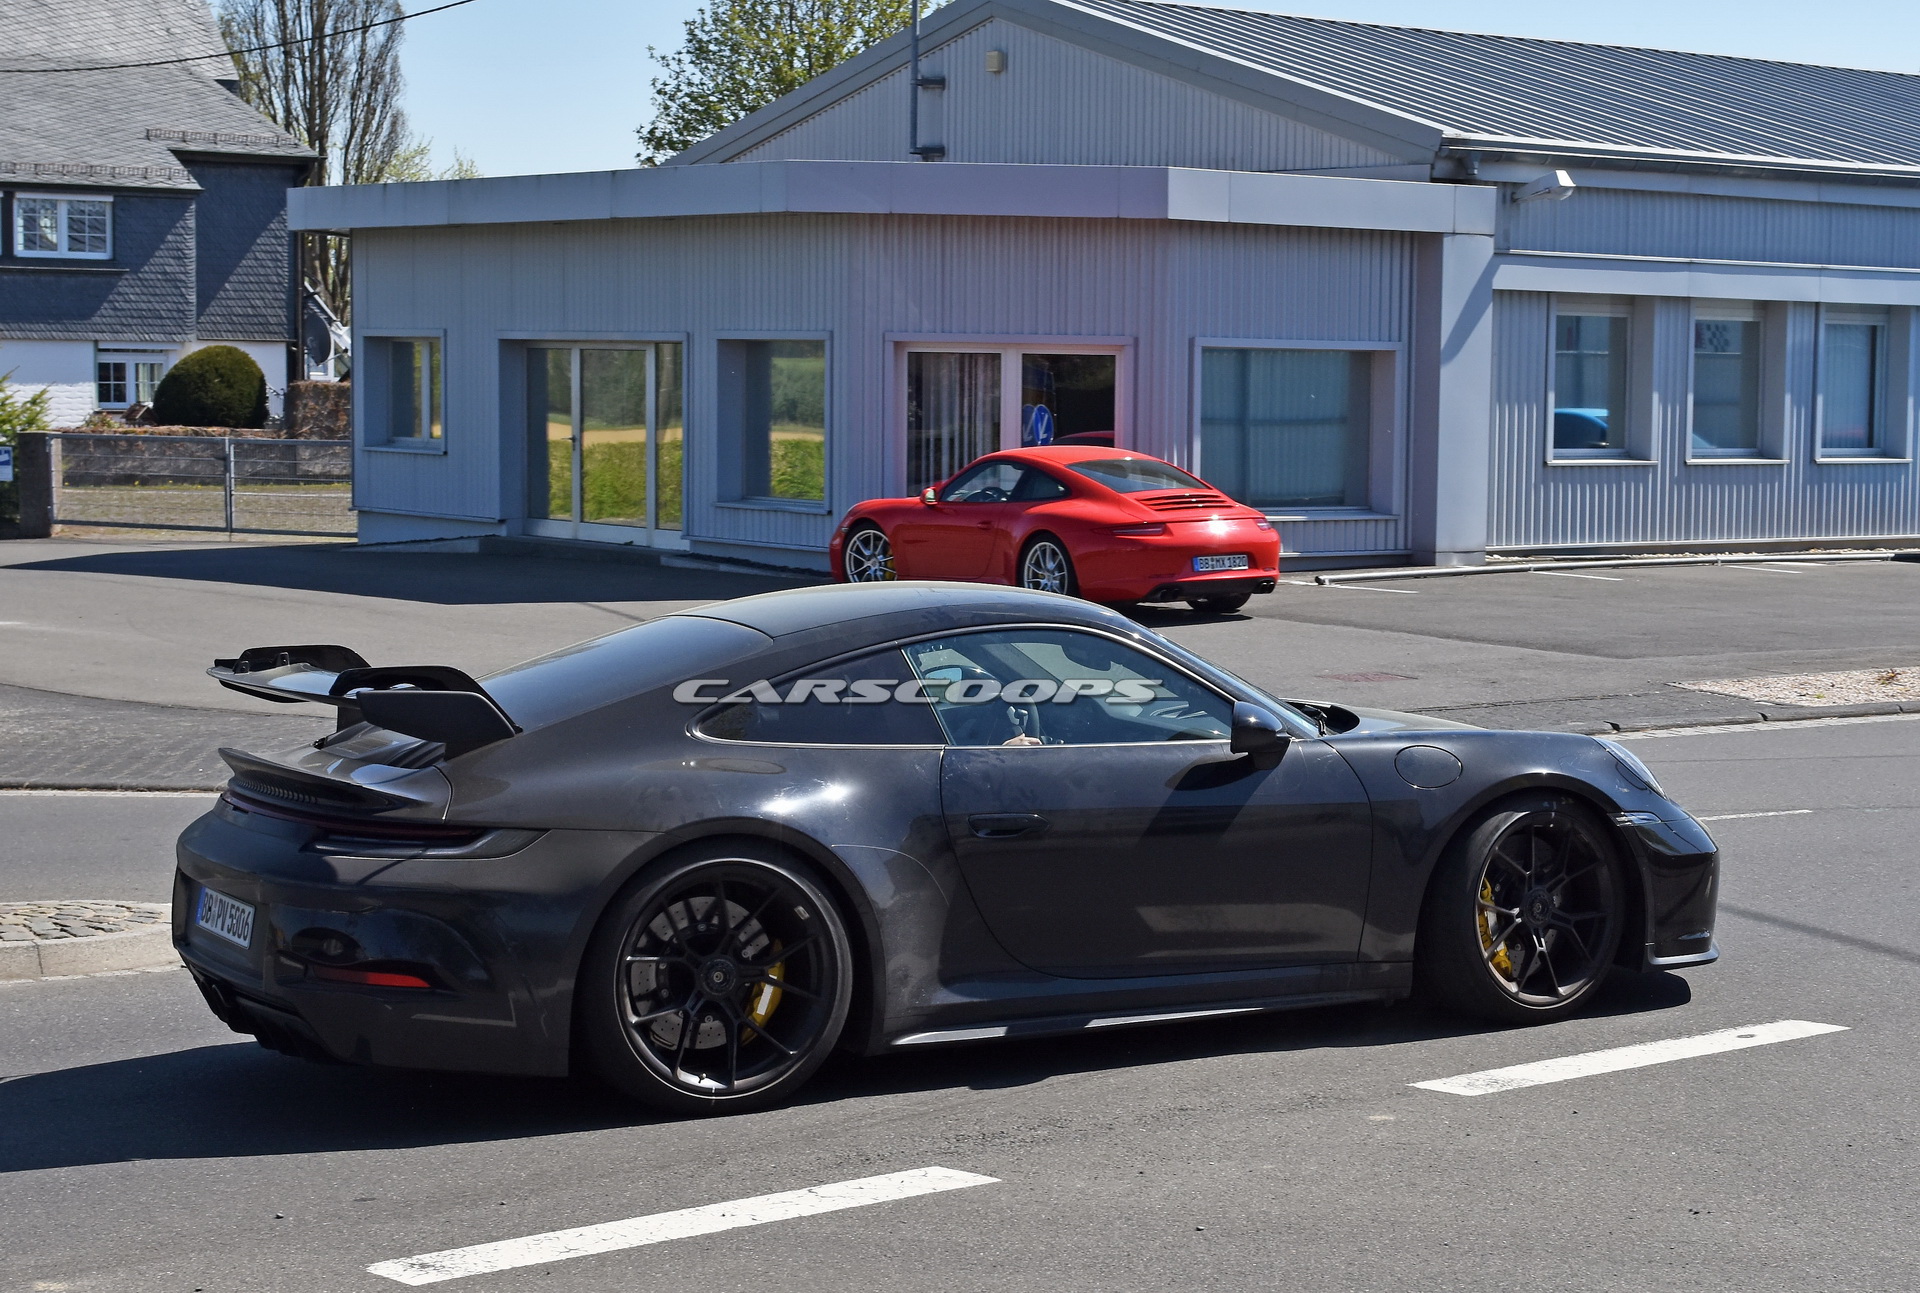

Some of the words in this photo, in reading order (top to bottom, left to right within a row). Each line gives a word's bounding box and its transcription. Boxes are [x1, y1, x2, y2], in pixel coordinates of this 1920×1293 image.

[1199, 558, 1209, 569] BB
[201, 892, 213, 923] BB
[215, 898, 229, 931] PV
